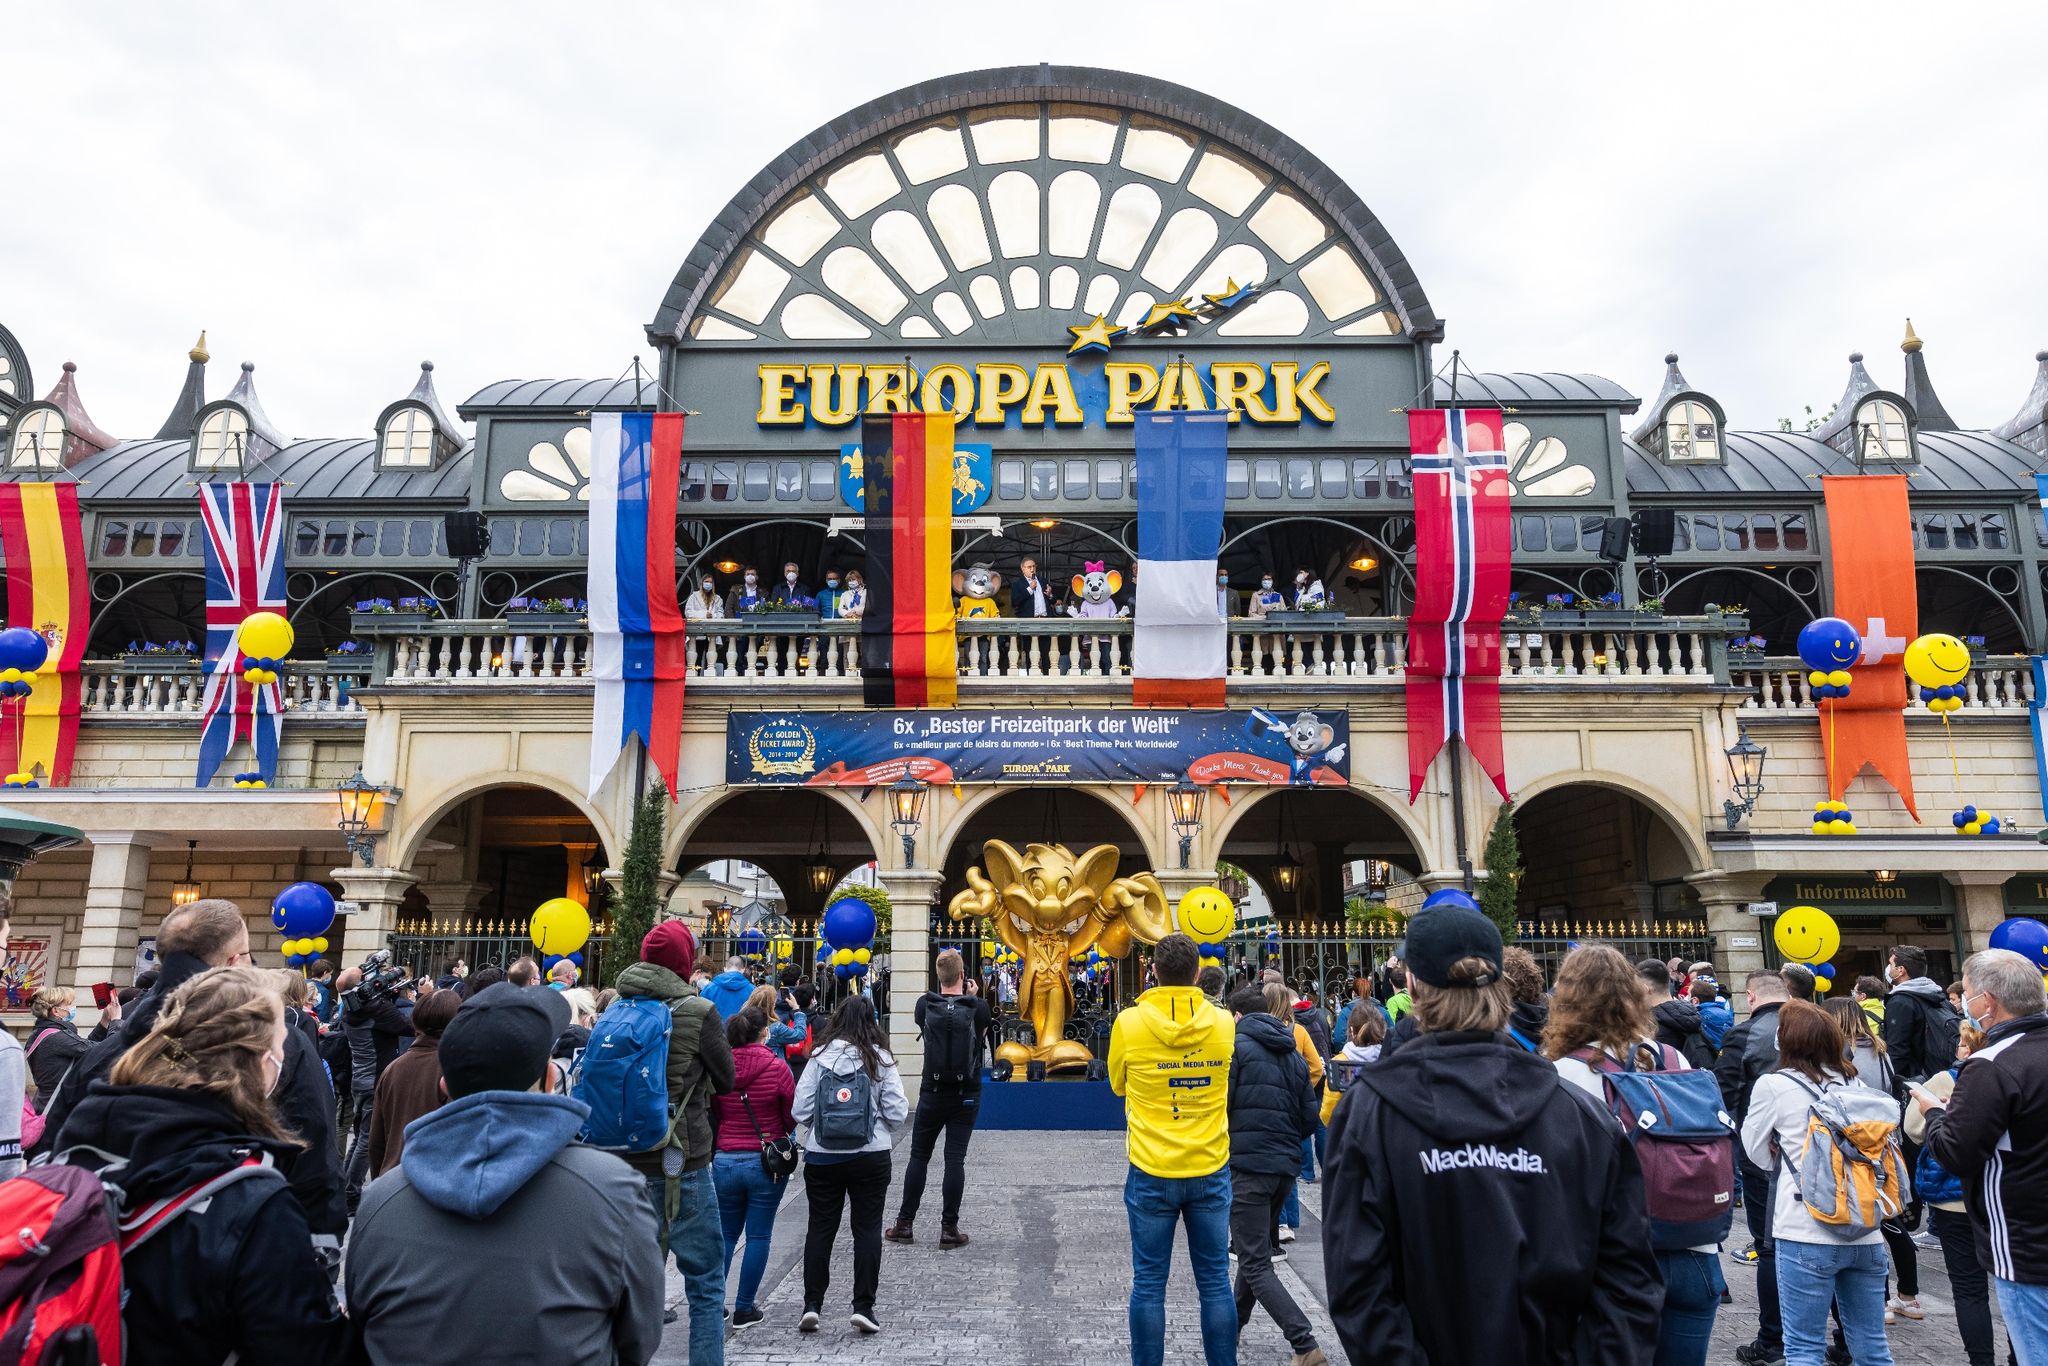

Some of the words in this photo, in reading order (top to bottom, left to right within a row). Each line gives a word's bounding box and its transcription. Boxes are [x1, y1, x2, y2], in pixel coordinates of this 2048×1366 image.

[757, 363, 1084, 426] EUROPA
[1104, 361, 1336, 426] PARK
[893, 717, 915, 735] 6x
[921, 716, 985, 737] „Bester
[990, 716, 1092, 737] Freizeitpark
[1098, 716, 1127, 734] der
[1132, 716, 1179, 734] Welt“
[764, 731, 774, 739] 6x
[775, 731, 801, 739] GOLDEN
[760, 740, 780, 748] TICKET
[781, 740, 805, 748] AWARD
[893, 741, 904, 749] 6x
[944, 741, 962, 750] parc
[963, 740, 973, 748] de
[975, 739, 999, 748] loisirs
[1001, 740, 1011, 748] du
[1013, 740, 1039, 748] monde
[1050, 740, 1061, 748] 6x
[1085, 740, 1113, 748] Theme
[1115, 740, 1134, 748] Park
[1002, 764, 1041, 773] EUROPA
[1045, 764, 1071, 773] PARK
[1195, 763, 1221, 776] Danke
[1222, 759, 1247, 770] Merci
[1249, 761, 1272, 777] Thank
[1270, 772, 1284, 781] you
[1795, 883, 1907, 900] Information
[1157, 1062, 1181, 1070] SOCIAL
[1418, 1142, 1548, 1175] MackMedia.
